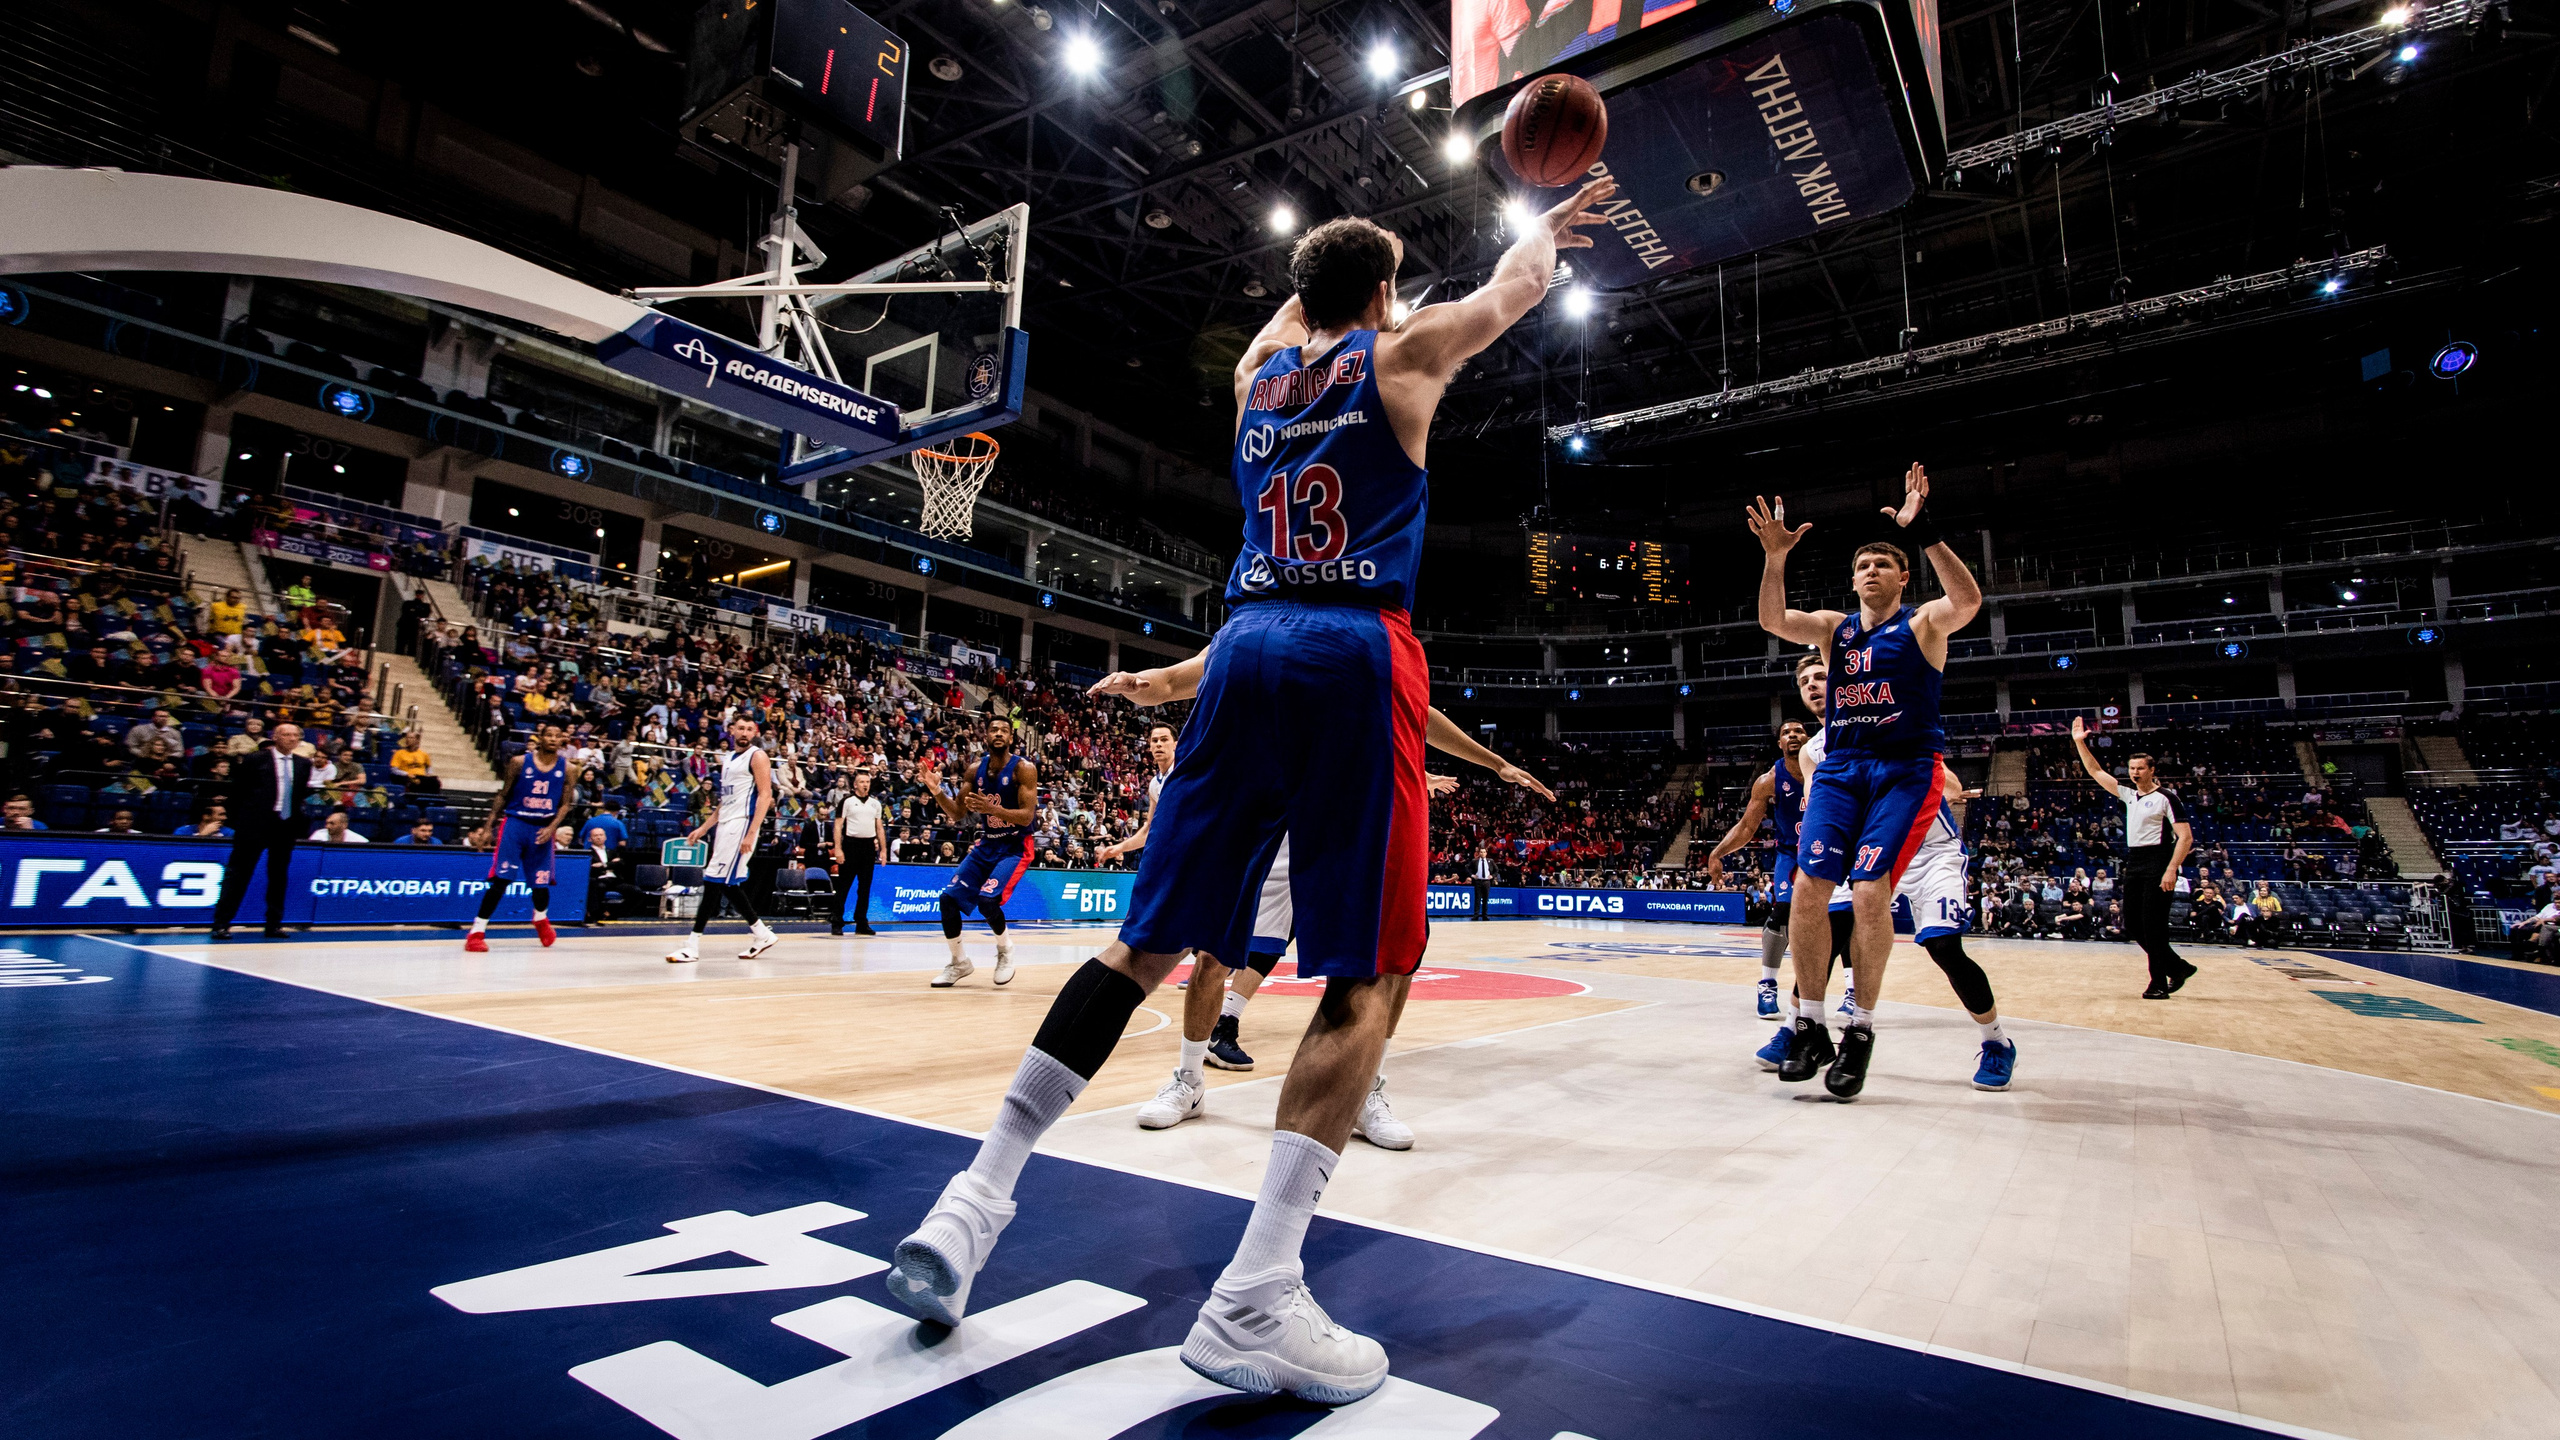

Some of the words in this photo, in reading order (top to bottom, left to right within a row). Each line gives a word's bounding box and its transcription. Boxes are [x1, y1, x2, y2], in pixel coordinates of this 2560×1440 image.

[1744, 53, 1823, 161] ЛЕГЕНД
[1791, 161, 1850, 225] ПАРК
[1250, 350, 1366, 411] RODRIGUEZ
[1280, 410, 1368, 440] NORNICKEL
[1258, 463, 1348, 562] 13
[1845, 646, 1873, 675] 31
[1835, 682, 1895, 709] CSKA
[531, 780, 549, 794] 21
[1854, 845, 1883, 871] 31
[0, 858, 225, 908] ГАЗ
[310, 879, 451, 897] СТРАХОВАЯ
[1080, 888, 1117, 912] ВТБ
[1427, 891, 1471, 910] СОГАЗ
[1538, 894, 1624, 913] СОГАЗ
[1646, 902, 1692, 911] СТРАХОВАЯ
[1694, 904, 1726, 912] ГРУППА
